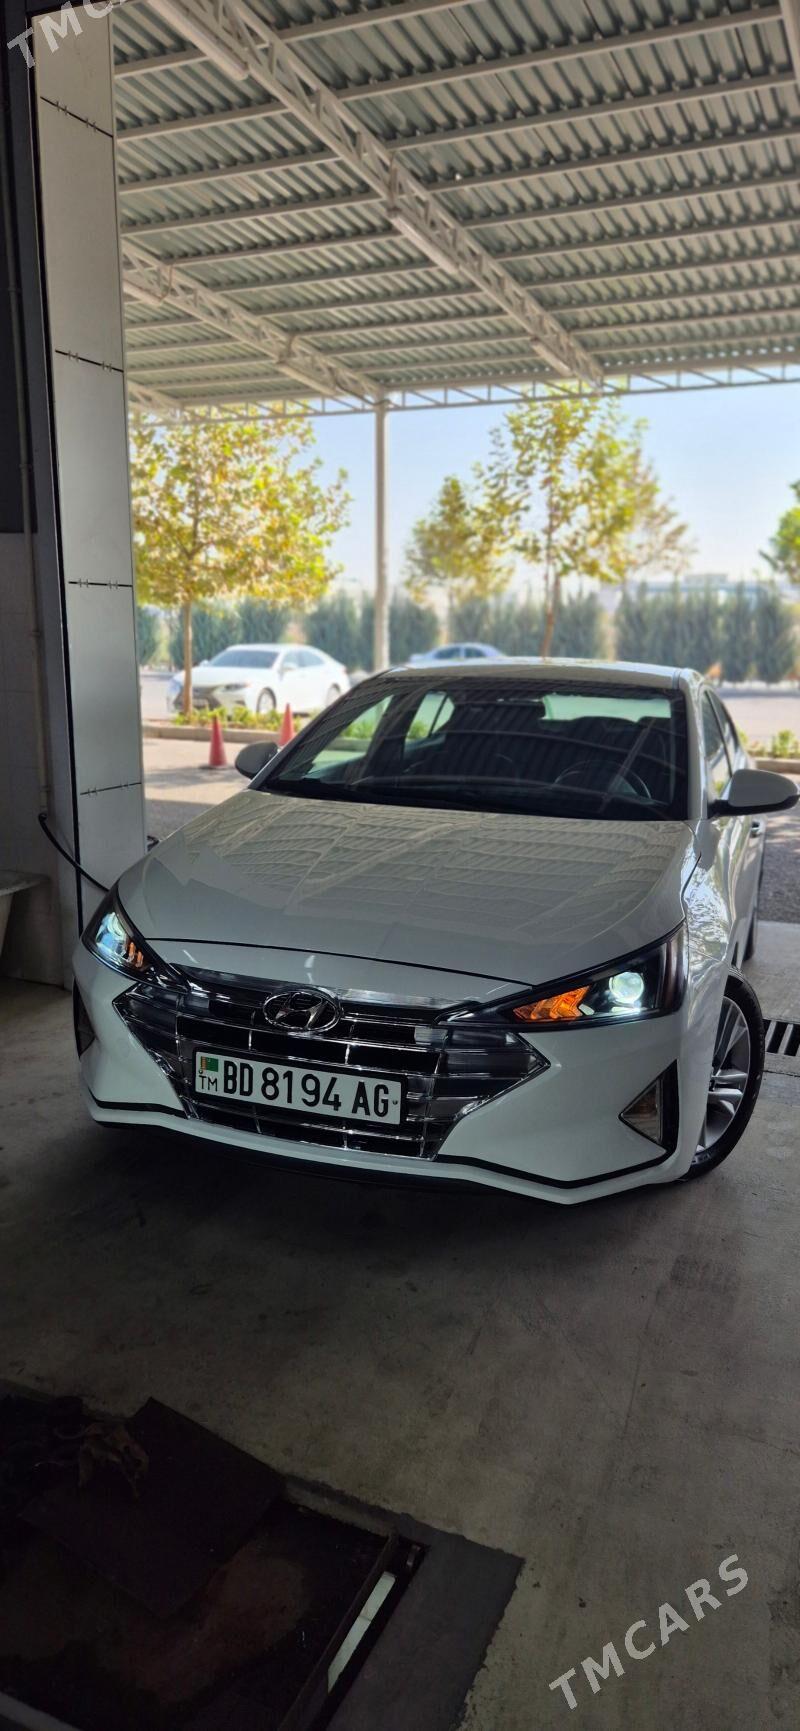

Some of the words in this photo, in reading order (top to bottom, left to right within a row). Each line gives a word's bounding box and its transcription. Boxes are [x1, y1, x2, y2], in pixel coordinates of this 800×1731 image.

[198, 1075, 218, 1092] TM
[223, 1060, 254, 1097] BD
[261, 1067, 342, 1111] 8194
[351, 1081, 389, 1118] AG
